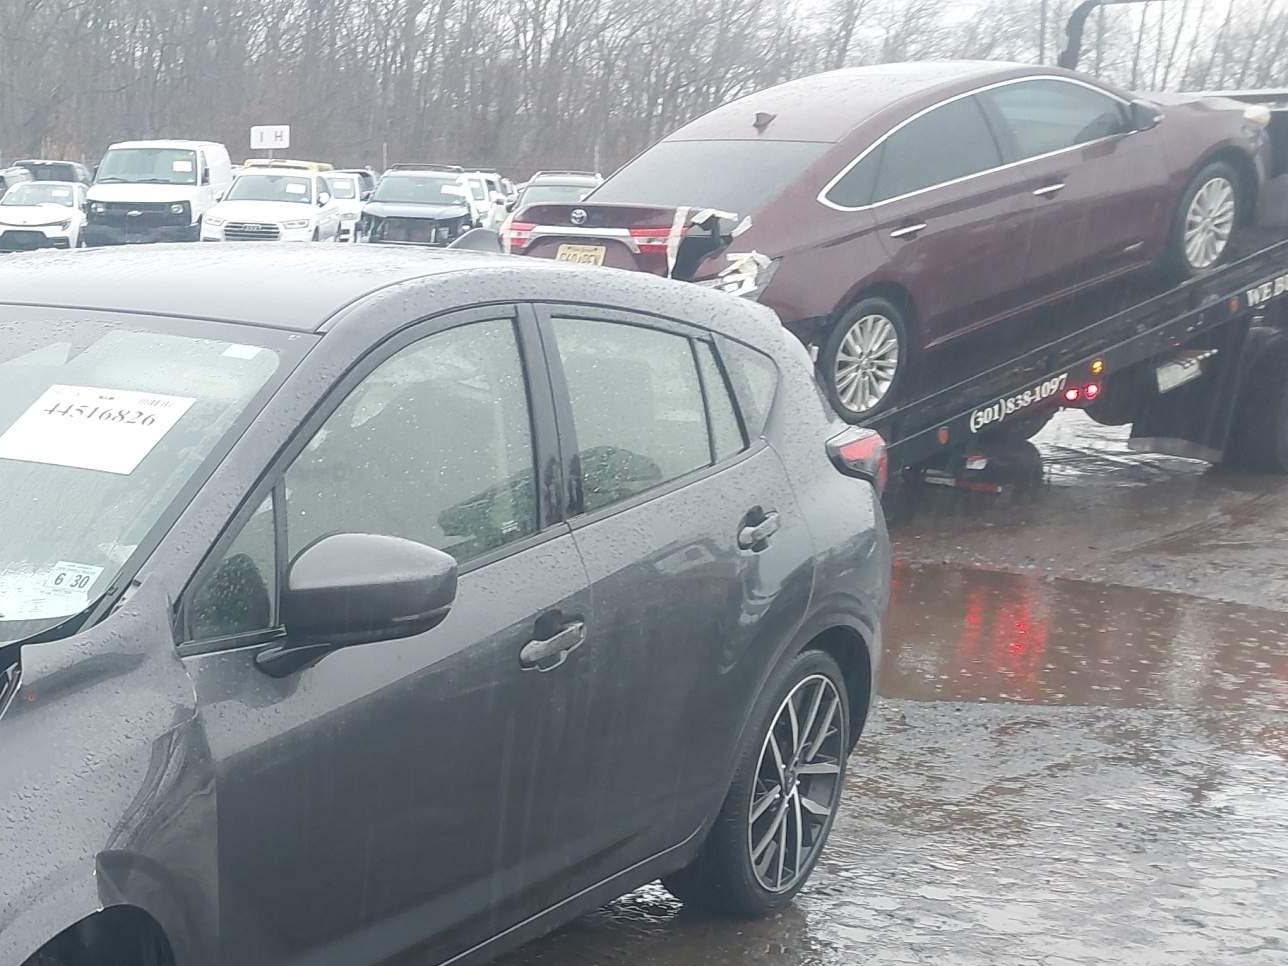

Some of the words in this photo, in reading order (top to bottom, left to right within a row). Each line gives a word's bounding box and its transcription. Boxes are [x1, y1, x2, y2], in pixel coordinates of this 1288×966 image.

[274, 130, 284, 142] H
[970, 373, 1068, 434] (301)838-1097
[40, 402, 157, 427] 44516826
[54, 572, 66, 586] 6
[69, 574, 90, 589] 30
